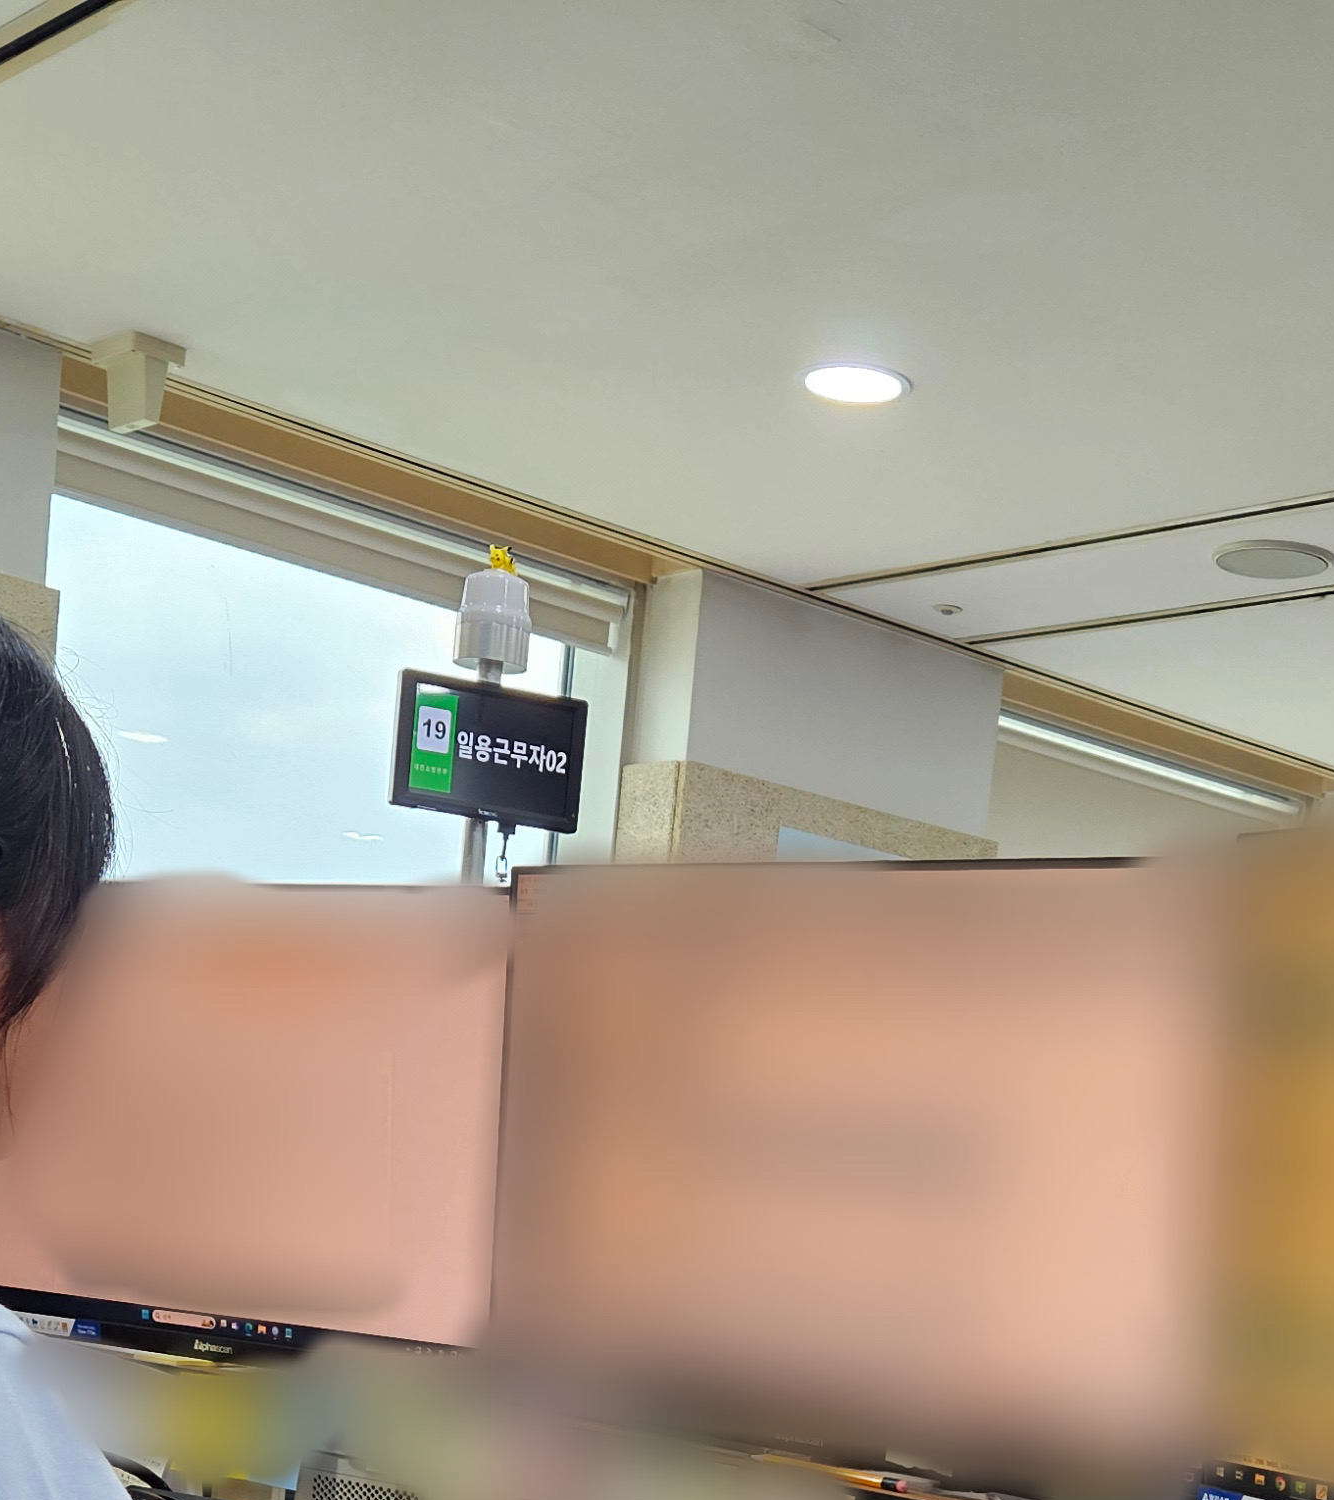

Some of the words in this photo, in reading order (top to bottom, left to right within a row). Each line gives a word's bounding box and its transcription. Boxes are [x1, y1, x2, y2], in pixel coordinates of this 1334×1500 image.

[422, 718, 447, 740] 19
[456, 730, 568, 775] 일용근무자02
[193, 1339, 234, 1356] Alphascan
